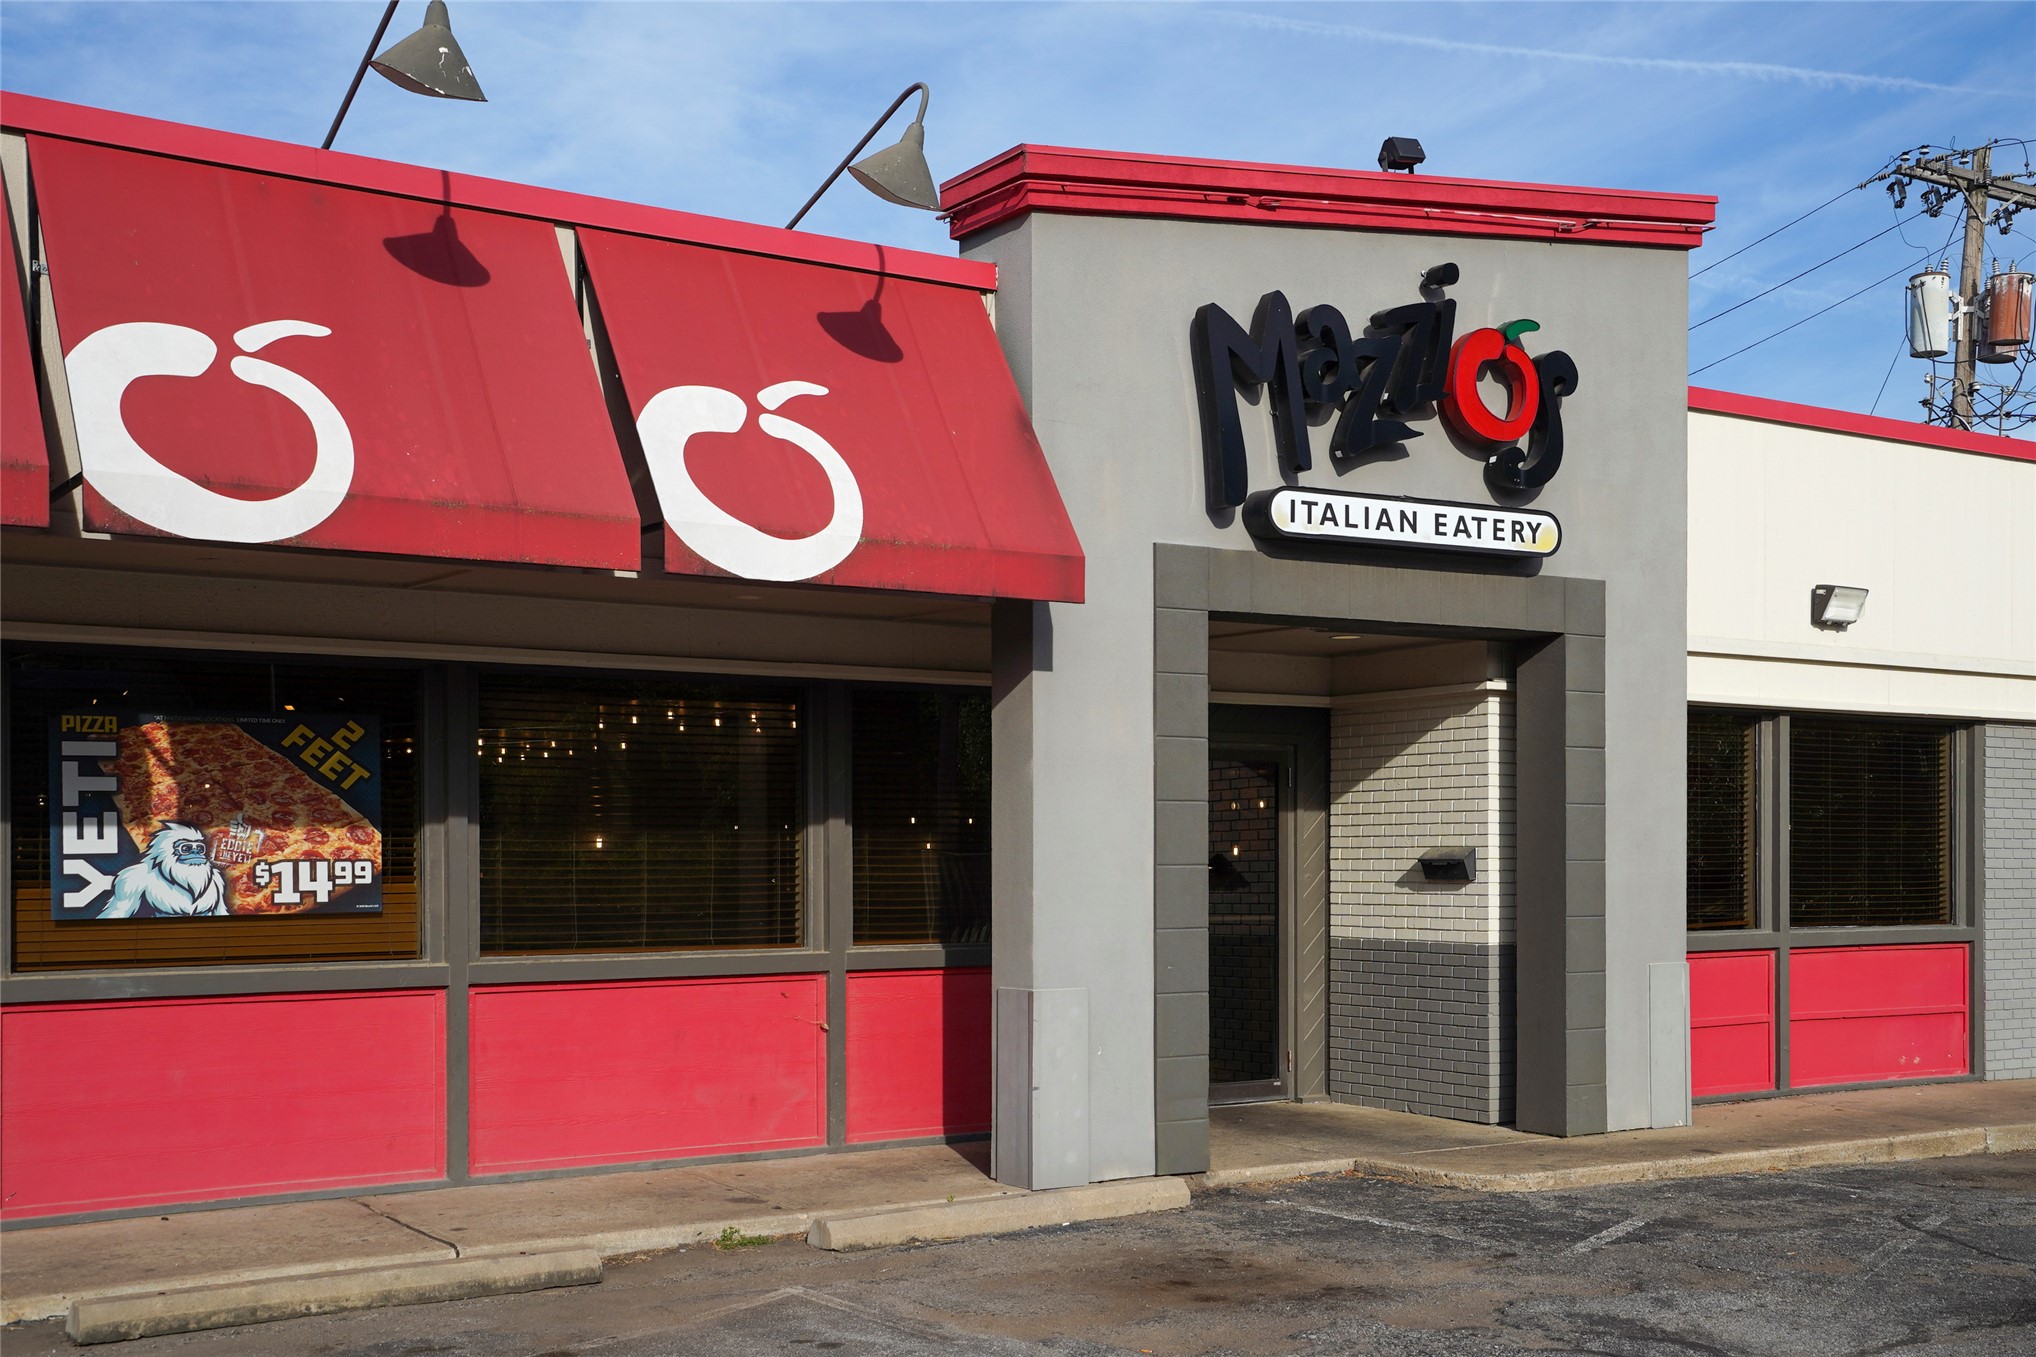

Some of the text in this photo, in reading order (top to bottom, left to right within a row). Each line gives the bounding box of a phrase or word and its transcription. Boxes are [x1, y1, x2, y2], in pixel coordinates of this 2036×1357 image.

[1289, 498, 1543, 545] ITALIAN EATERY
[61, 714, 118, 733] PIZZA
[330, 720, 365, 750] 2
[281, 723, 371, 790] FEET
[61, 741, 118, 908] YETI
[220, 838, 253, 854] EDDIE
